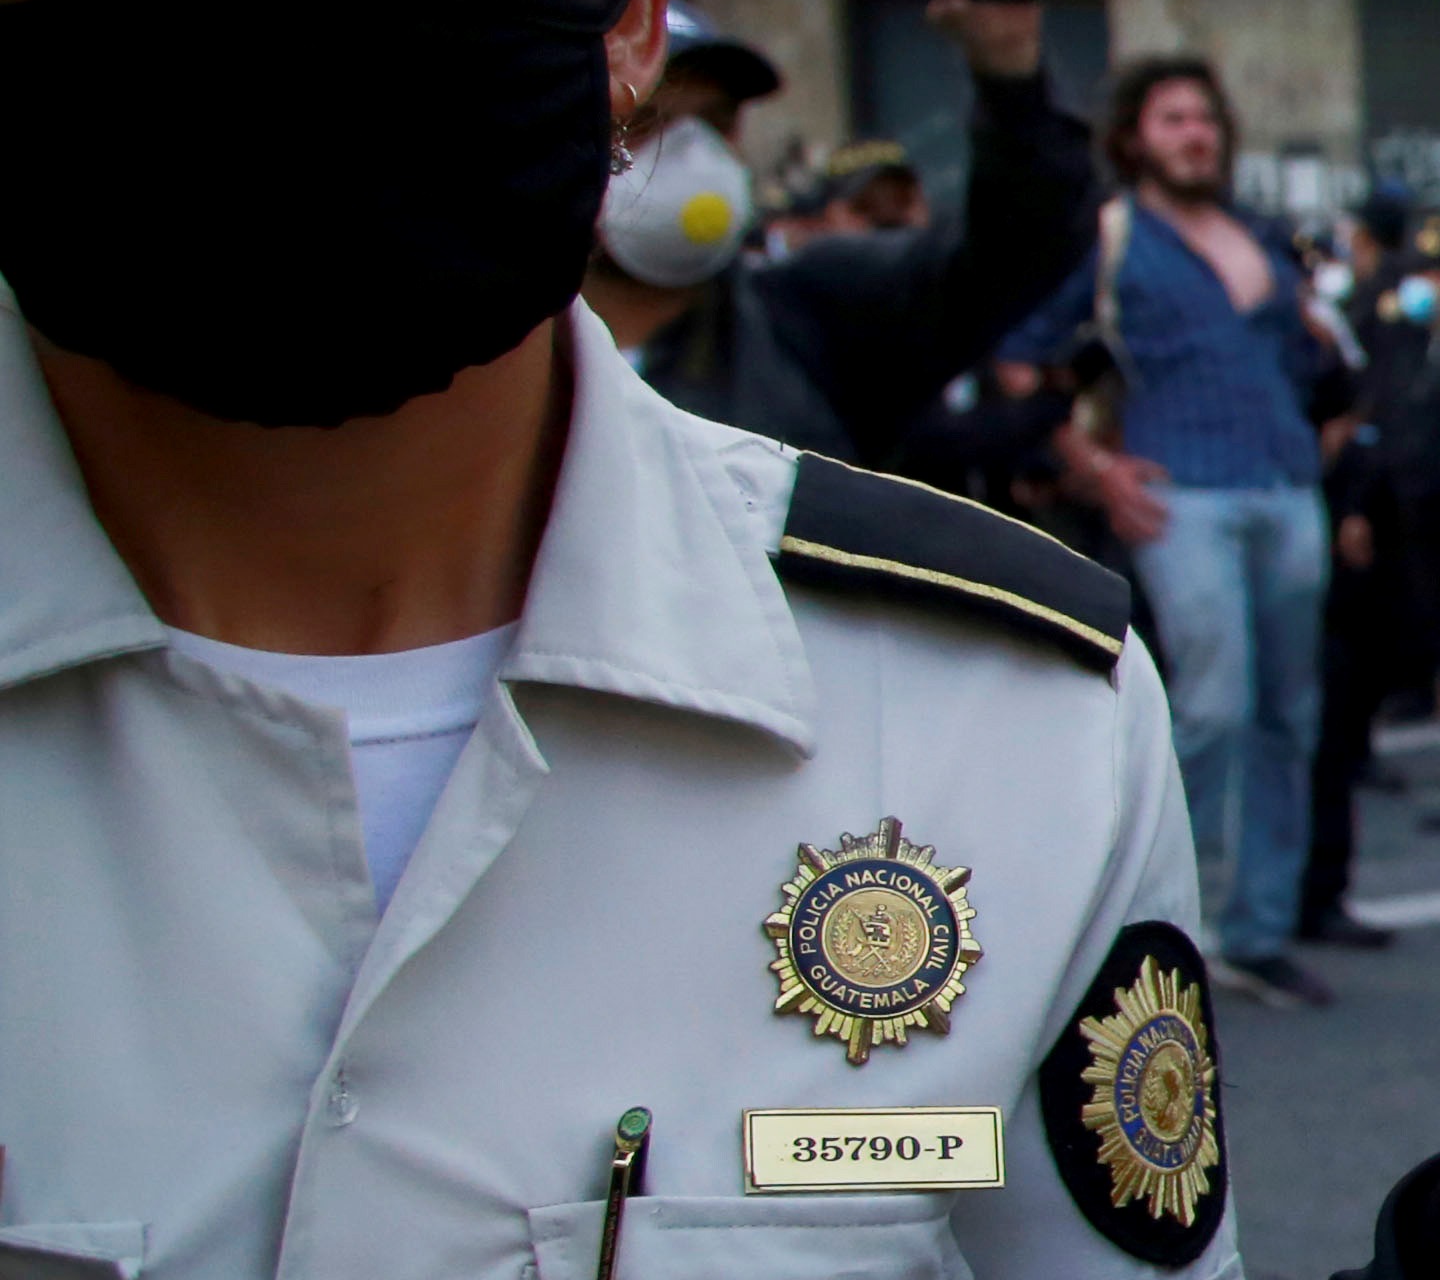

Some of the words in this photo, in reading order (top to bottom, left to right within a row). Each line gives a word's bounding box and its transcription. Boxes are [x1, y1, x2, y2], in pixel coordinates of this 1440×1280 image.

[799, 882, 844, 954] POLICIA
[845, 869, 941, 919] NACIONAL
[925, 924, 950, 970] CIVIL
[810, 965, 930, 1008] GUATEMALA
[792, 1135, 964, 1162] 35790-P
